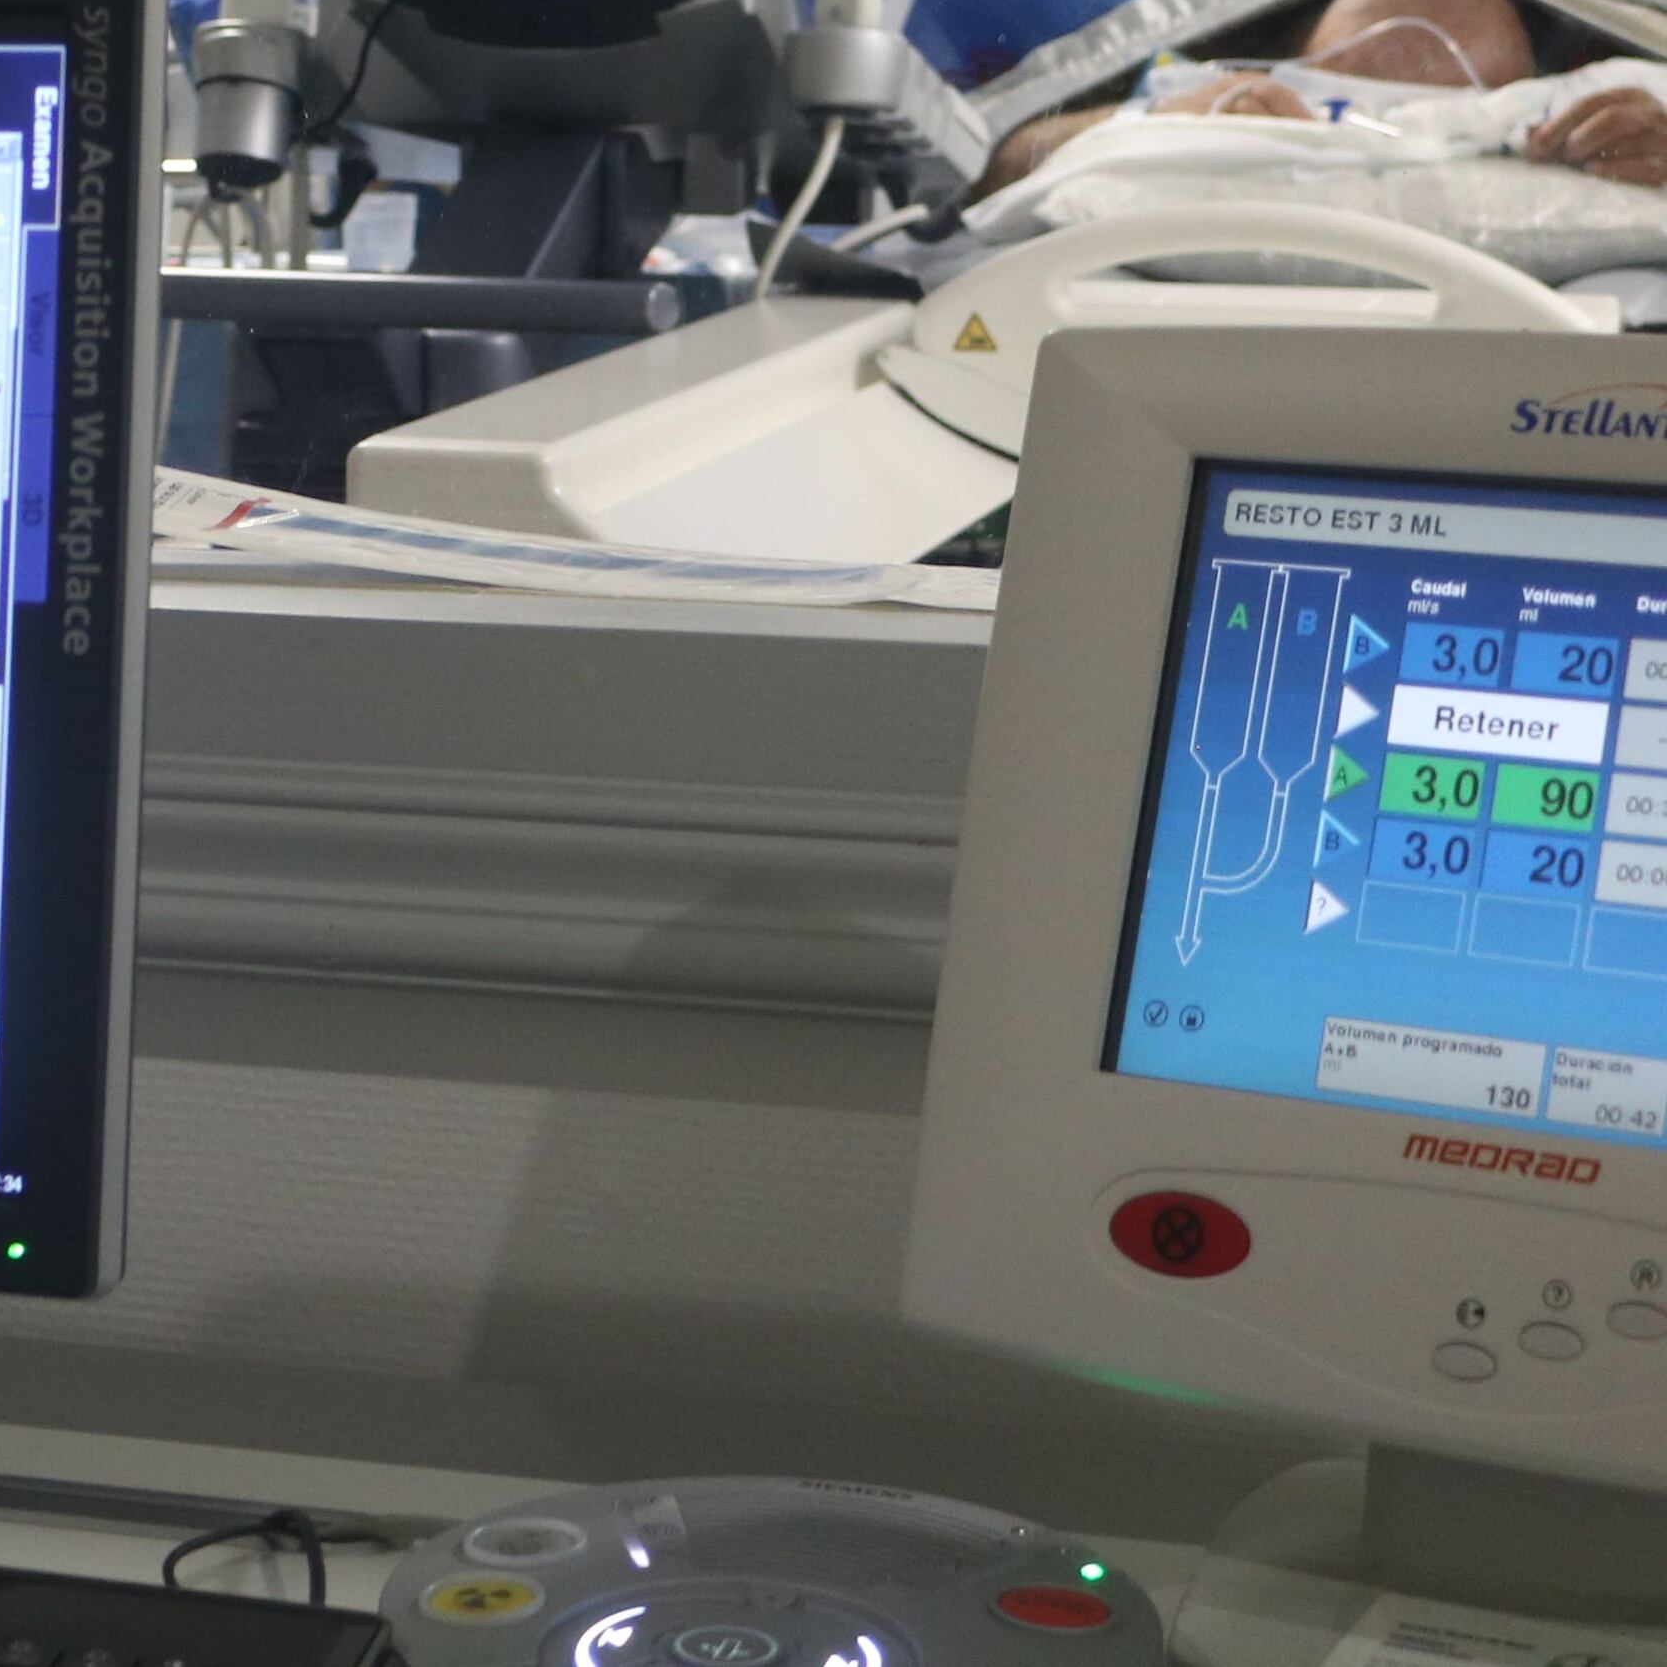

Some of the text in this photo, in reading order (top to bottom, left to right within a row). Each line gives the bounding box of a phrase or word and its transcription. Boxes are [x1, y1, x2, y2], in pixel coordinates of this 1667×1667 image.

[30, 85, 59, 190] Examen
[59, 6, 115, 657] syngo Acquisition Workplace
[1234, 501, 1447, 537] RESTO EST 3 ML
[1409, 576, 1467, 599] Caudal
[1521, 585, 1597, 609] Volumen
[1227, 602, 1247, 630] A
[1432, 633, 1500, 680] 3,0
[1557, 643, 1614, 686] 20
[1433, 704, 1560, 742] Retener
[1411, 764, 1480, 813] 3,0
[1540, 777, 1594, 820] 90
[1402, 830, 1470, 879] 3,0
[1528, 844, 1586, 888] 20
[1326, 1021, 1503, 1059] Volumen programado
[1485, 1084, 1531, 1110] 130
[1551, 1072, 1590, 1091] total
